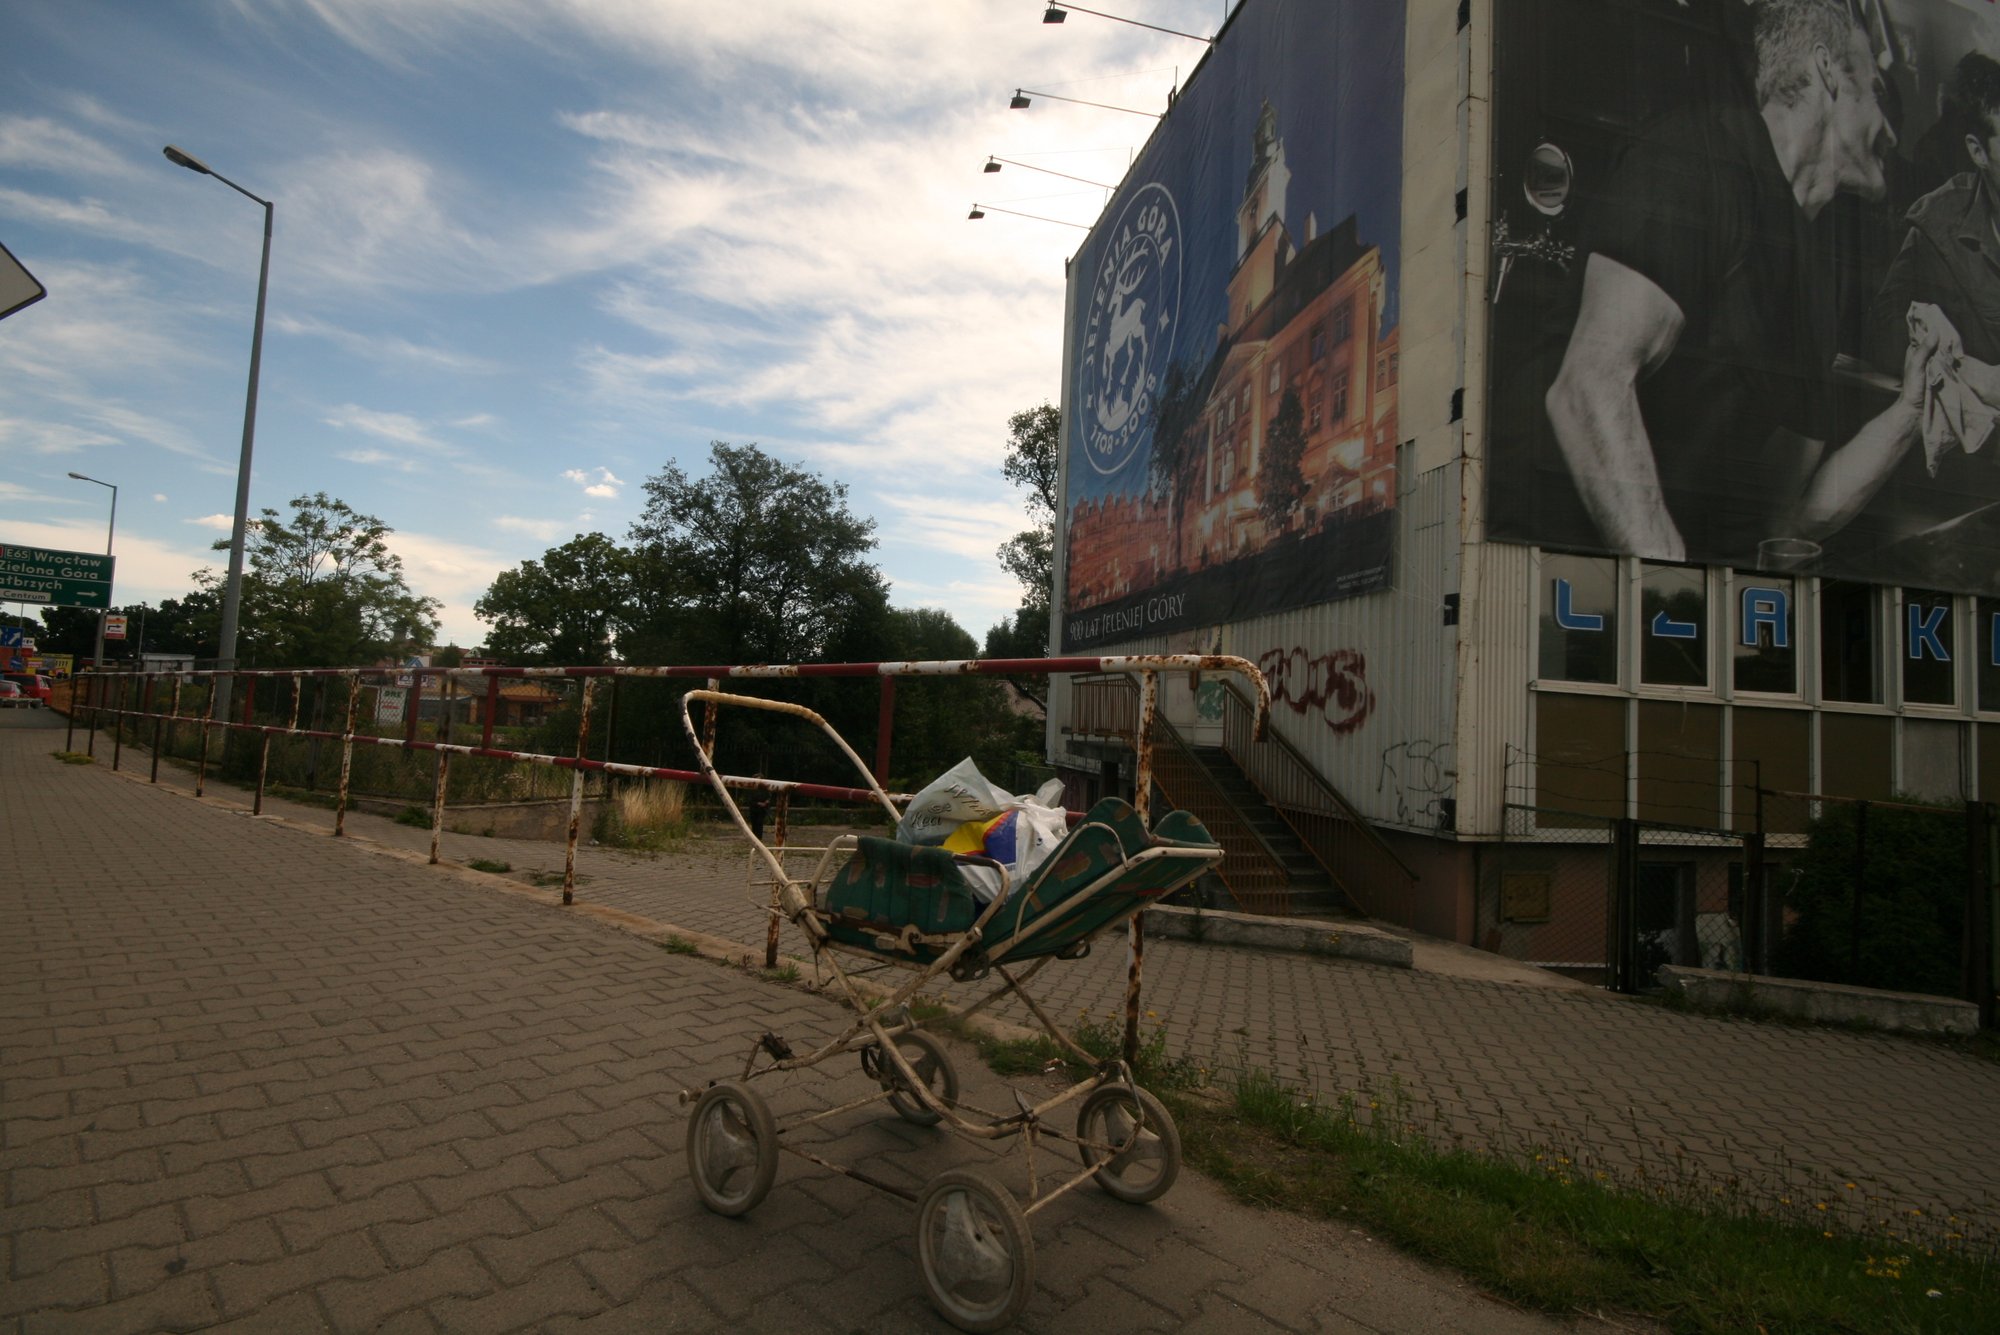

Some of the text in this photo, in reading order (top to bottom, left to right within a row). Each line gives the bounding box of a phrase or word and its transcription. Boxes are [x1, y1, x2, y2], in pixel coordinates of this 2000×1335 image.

[1086, 196, 1173, 367] JELENIA GÓRA
[34, 551, 101, 567] Wrocław
[0, 560, 99, 580] Zielona Góra
[0, 576, 62, 590] ałbrzych
[3, 591, 46, 600] Centrum
[1070, 593, 1186, 641] 900 LAT JELENIEJ GÓRY
